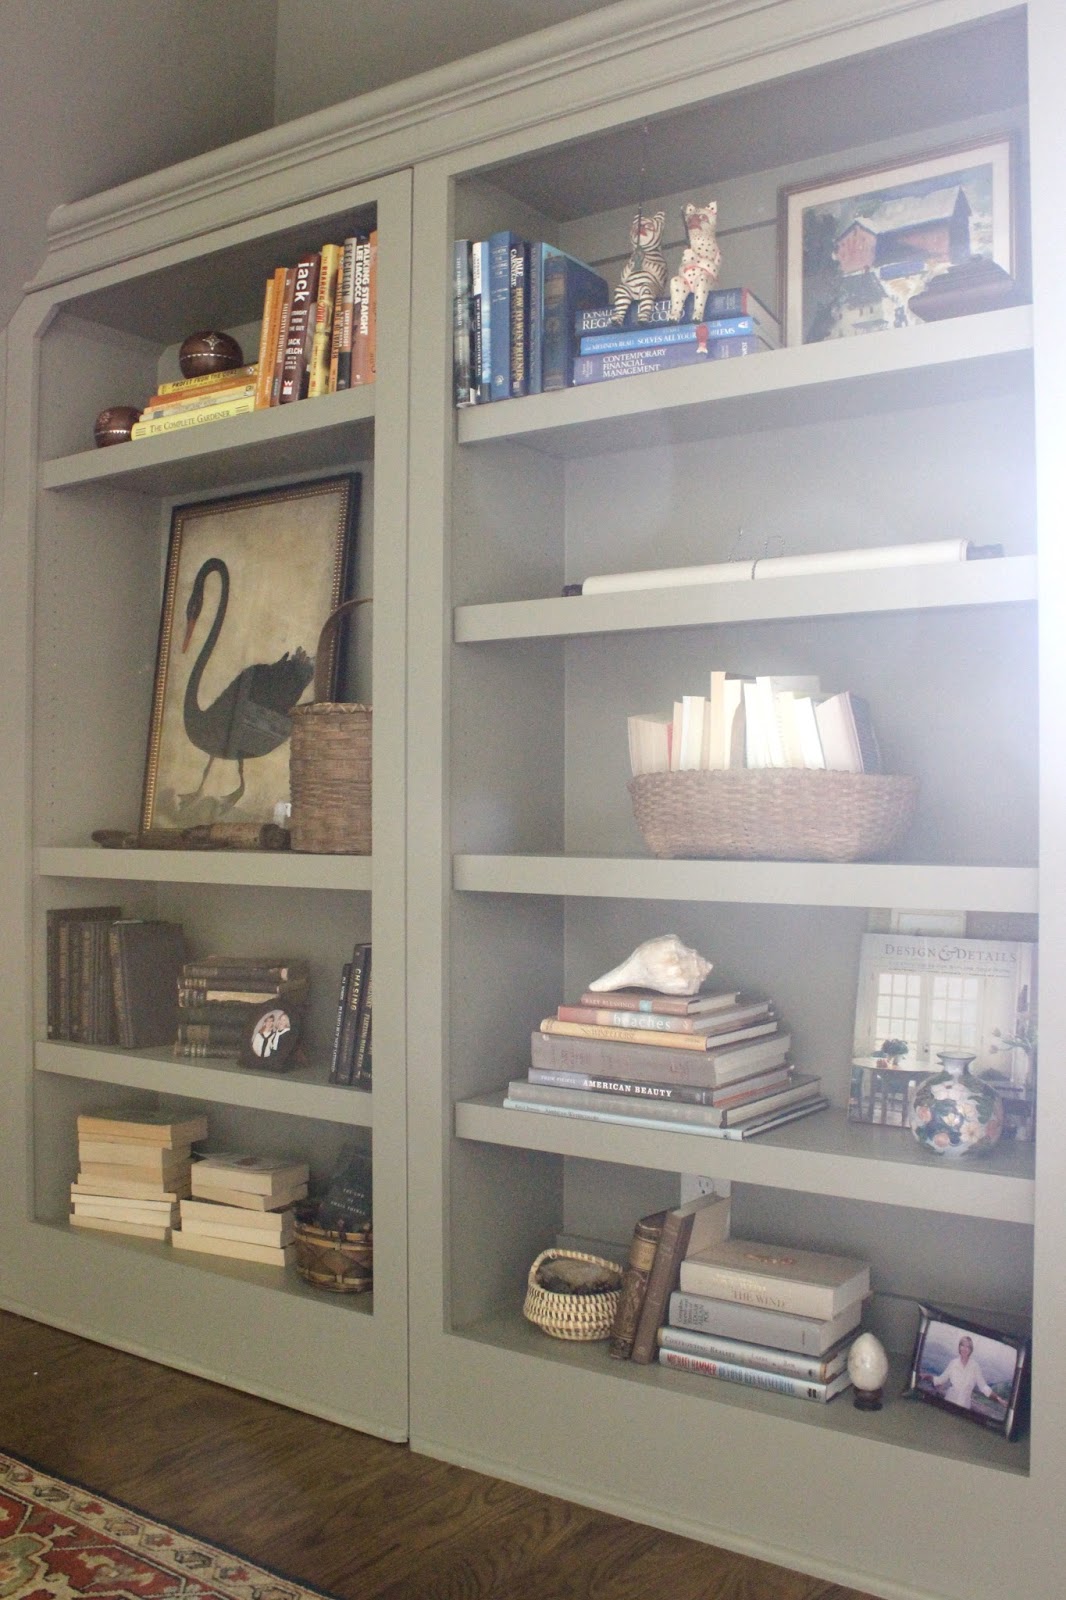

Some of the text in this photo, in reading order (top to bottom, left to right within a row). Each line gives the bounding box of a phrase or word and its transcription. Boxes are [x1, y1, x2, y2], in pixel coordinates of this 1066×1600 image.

[342, 243, 352, 296] EXECUTION
[295, 262, 314, 302] jack
[354, 261, 363, 304] IACOCCA
[360, 243, 370, 335] TALKING STRAIGHT
[603, 349, 667, 363] CONTEMPORARY
[603, 359, 645, 370] FINANCIAL
[603, 364, 660, 377] MANAGEMENT
[885, 944, 936, 957] DESIGN
[956, 948, 1017, 962] DETAILS
[351, 968, 361, 1011] CHASING
[614, 1014, 671, 1030] beaches
[583, 1080, 631, 1092] AMERICAN
[635, 1087, 672, 1097] BEAUTY
[667, 1353, 690, 1368] MICHAEL
[692, 1359, 716, 1375] HAMMER
